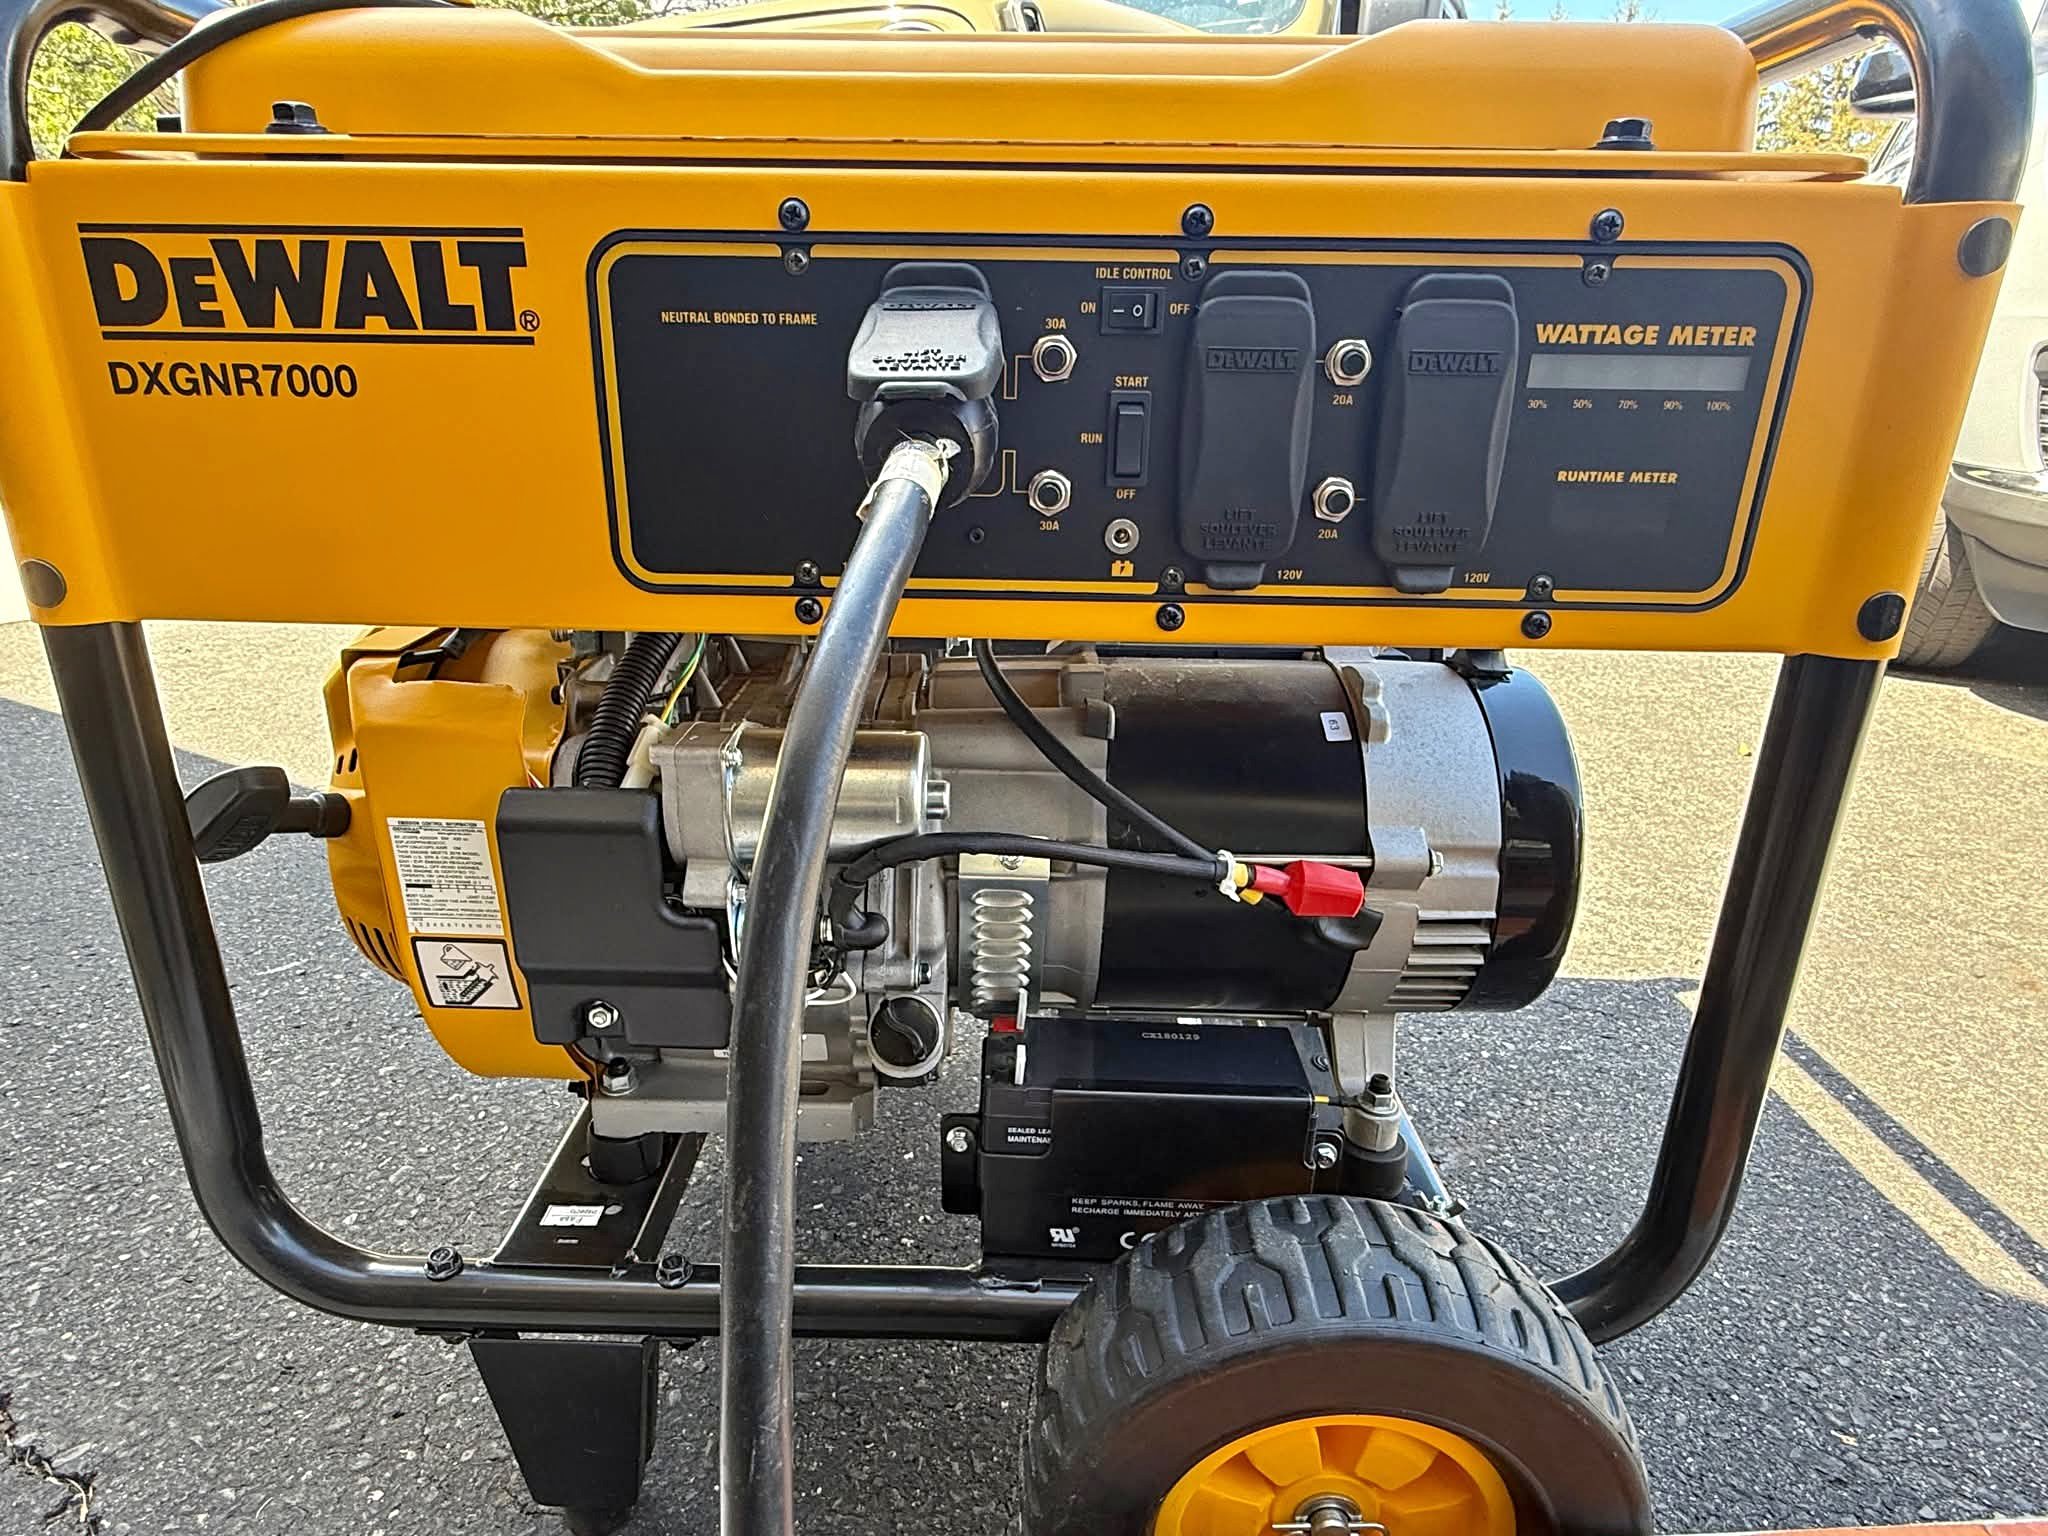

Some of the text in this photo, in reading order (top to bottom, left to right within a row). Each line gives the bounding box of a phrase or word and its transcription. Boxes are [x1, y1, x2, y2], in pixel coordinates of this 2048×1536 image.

[1096, 267, 1173, 280] IDLE CONTROL
[1081, 302, 1096, 313] ON
[1169, 303, 1190, 315] OFF
[661, 311, 817, 325] NEUTRAL BONDED TO FRAME
[1045, 318, 1067, 329] 30A
[1536, 324, 1757, 347] WATTAGE METER
[107, 361, 358, 398] DXGNR7000
[1115, 376, 1149, 387] START
[1333, 395, 1353, 405] 20A
[1527, 399, 1547, 409] 30%
[1572, 399, 1592, 409] 50%
[1618, 400, 1638, 409] 70%
[1663, 400, 1683, 410] 90%
[1706, 400, 1730, 411] 100%
[1080, 433, 1103, 444] RUN
[1557, 471, 1677, 483] RUNTIME METER
[1116, 489, 1136, 499] OFF
[1040, 521, 1059, 531] 30A
[1318, 529, 1338, 540] 20A
[1277, 569, 1303, 580] 120V
[1464, 572, 1490, 583] 120V
[1071, 1207, 1119, 1215] RECHARGE
[1123, 1209, 1181, 1217] IMMEDIATELY
